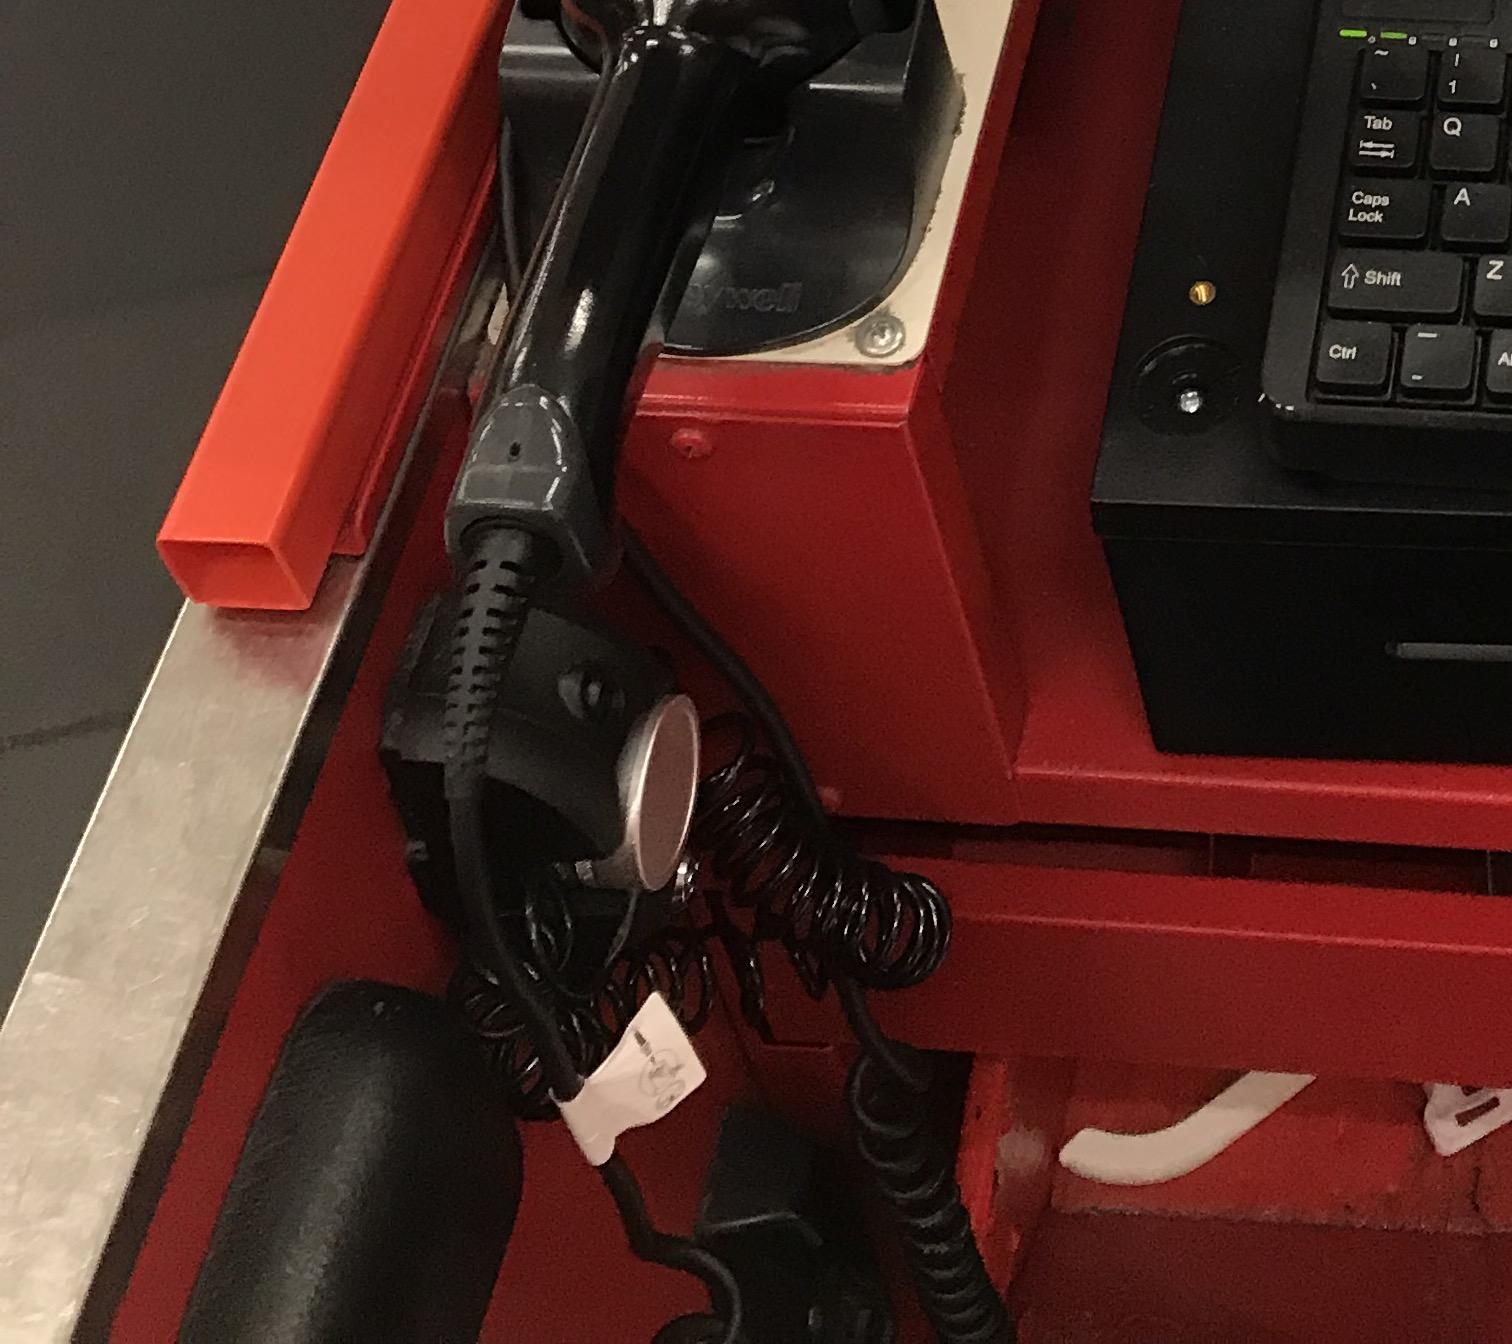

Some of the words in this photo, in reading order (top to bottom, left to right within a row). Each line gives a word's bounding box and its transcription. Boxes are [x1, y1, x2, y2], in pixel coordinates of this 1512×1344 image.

[1448, 79, 1457, 94] 1
[1363, 115, 1393, 131] Tab
[1443, 117, 1462, 137] Q
[1351, 190, 1390, 208] Caps
[1453, 187, 1471, 206] A
[1348, 208, 1384, 223] Lock
[1364, 269, 1402, 287] Shift
[1486, 259, 1504, 280] Z
[1328, 344, 1357, 360] Ctrl
